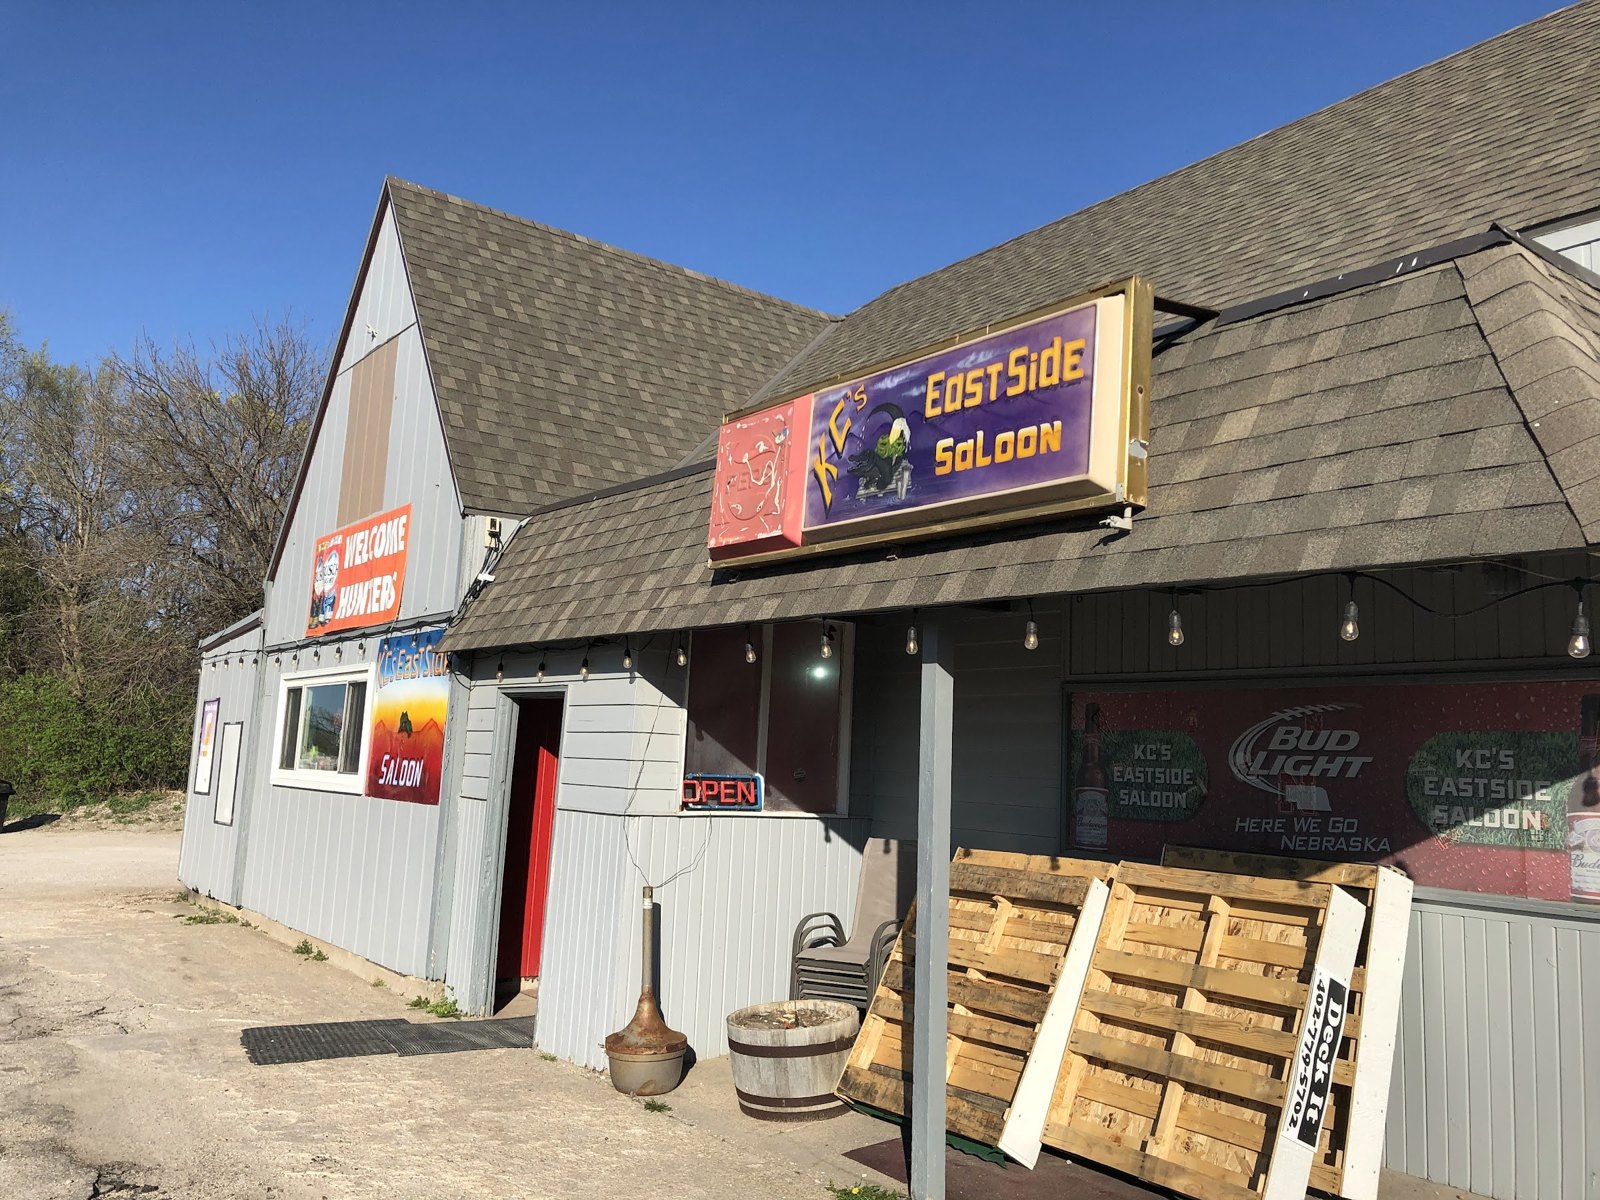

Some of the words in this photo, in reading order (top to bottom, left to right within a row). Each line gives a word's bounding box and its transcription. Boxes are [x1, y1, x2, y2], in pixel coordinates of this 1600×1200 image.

[343, 514, 408, 569] WELCOME
[1268, 726, 1360, 752] BUD
[1134, 744, 1172, 761] KC'S
[1247, 751, 1374, 778] LIGHT
[1456, 748, 1515, 770] KC'S
[1113, 767, 1194, 786] EASTSIDE
[1424, 776, 1552, 801] EASTSIDE
[681, 780, 756, 803] OPEN
[1119, 789, 1187, 809] SALOON
[1235, 816, 1286, 834] HERE
[1294, 816, 1322, 834] WE
[1328, 817, 1359, 834] GO
[1434, 804, 1541, 831] SALOON
[1281, 834, 1392, 853] NEBRASKA
[1314, 996, 1343, 1084] Deck
[1289, 978, 1326, 1129] 402-779-5702
[1306, 1091, 1324, 1125] It
